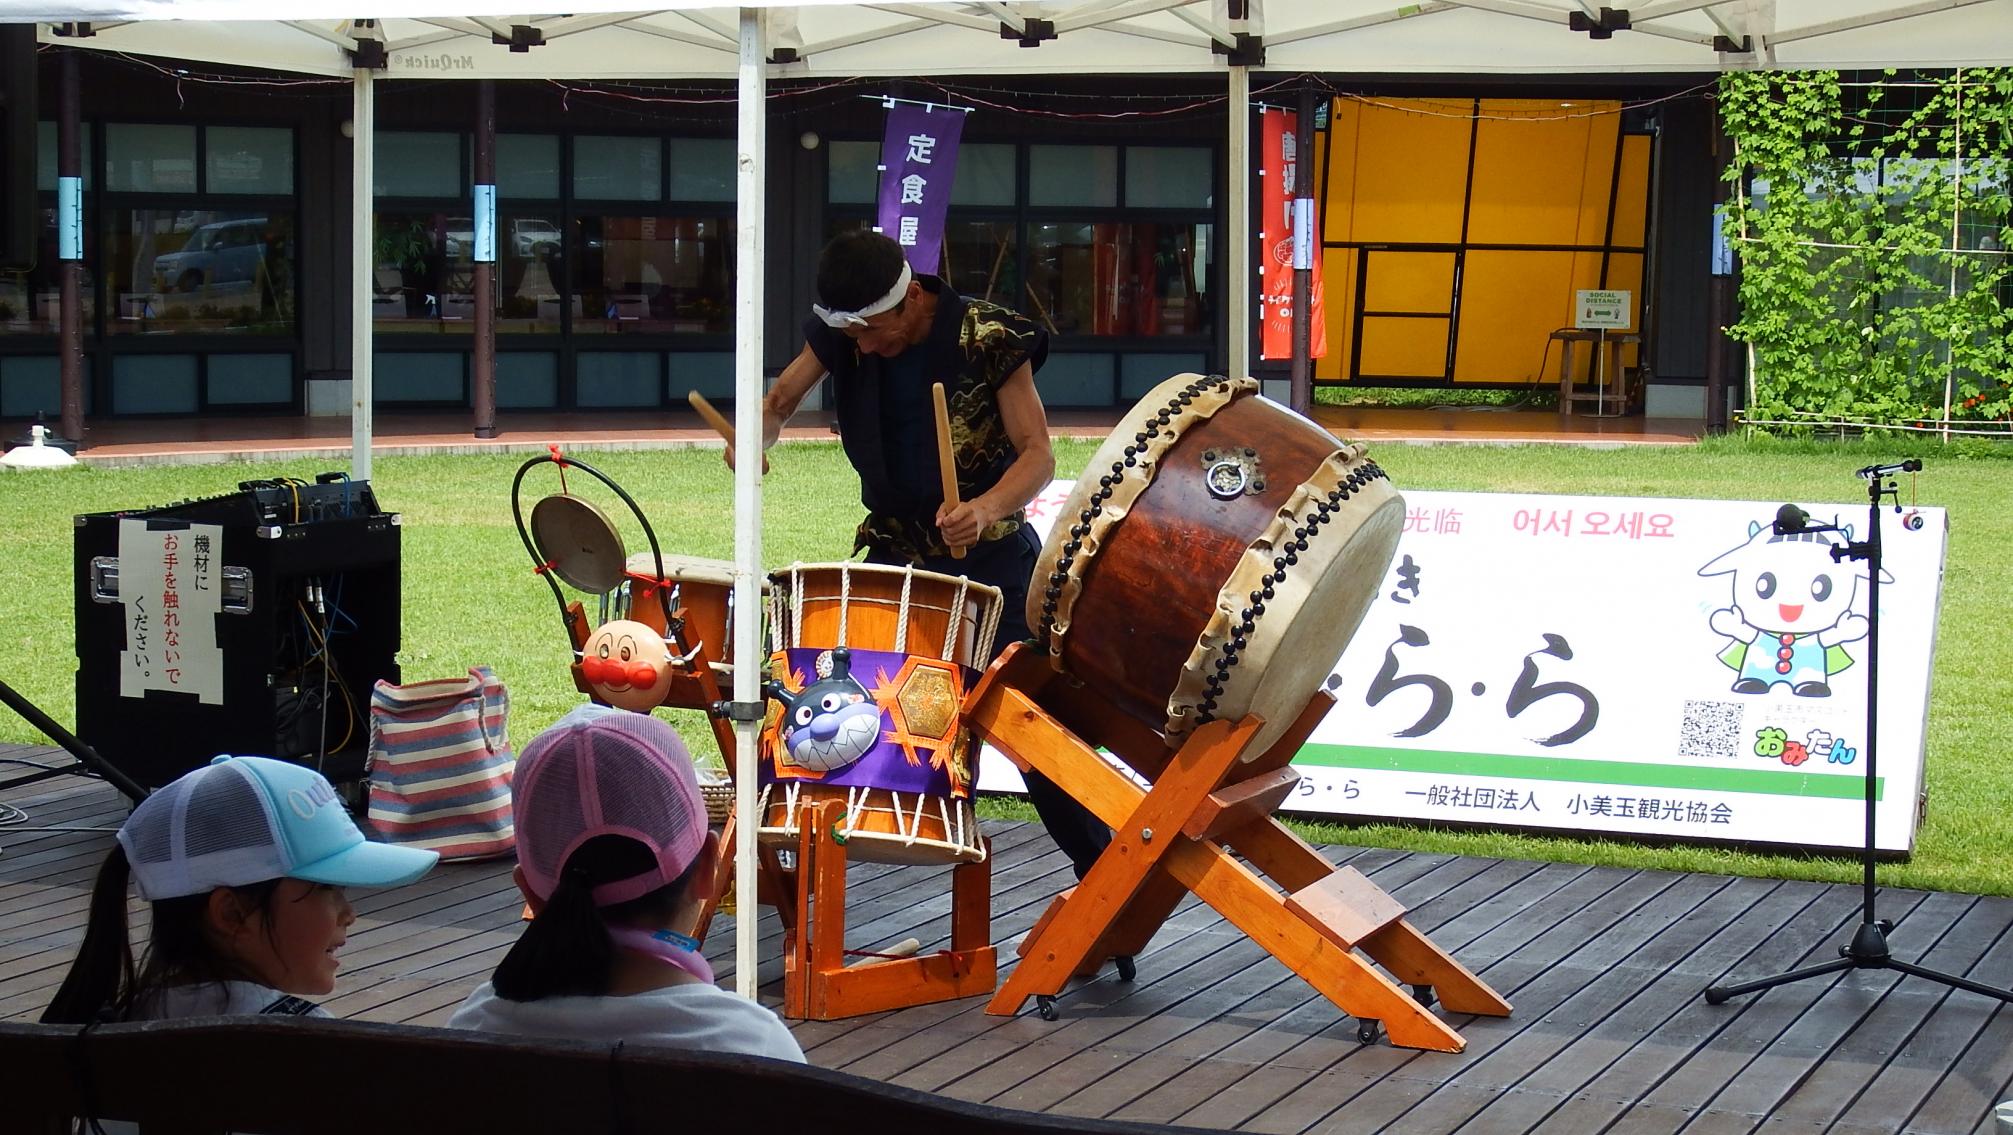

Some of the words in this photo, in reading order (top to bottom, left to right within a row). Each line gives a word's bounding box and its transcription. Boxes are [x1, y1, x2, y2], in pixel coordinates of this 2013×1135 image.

[899, 134, 936, 246] 定食屋
[1513, 508, 1573, 537] 어서
[1581, 511, 1675, 540] 오세요
[193, 534, 210, 591] 機材に
[1374, 554, 1421, 604] き
[163, 533, 181, 685] お手を触れないで
[134, 595, 151, 678] ください。
[1754, 726, 1857, 767] おみたん
[1405, 783, 1541, 812] 一般社団法人
[1566, 793, 1733, 825] 小美玉観光協会
